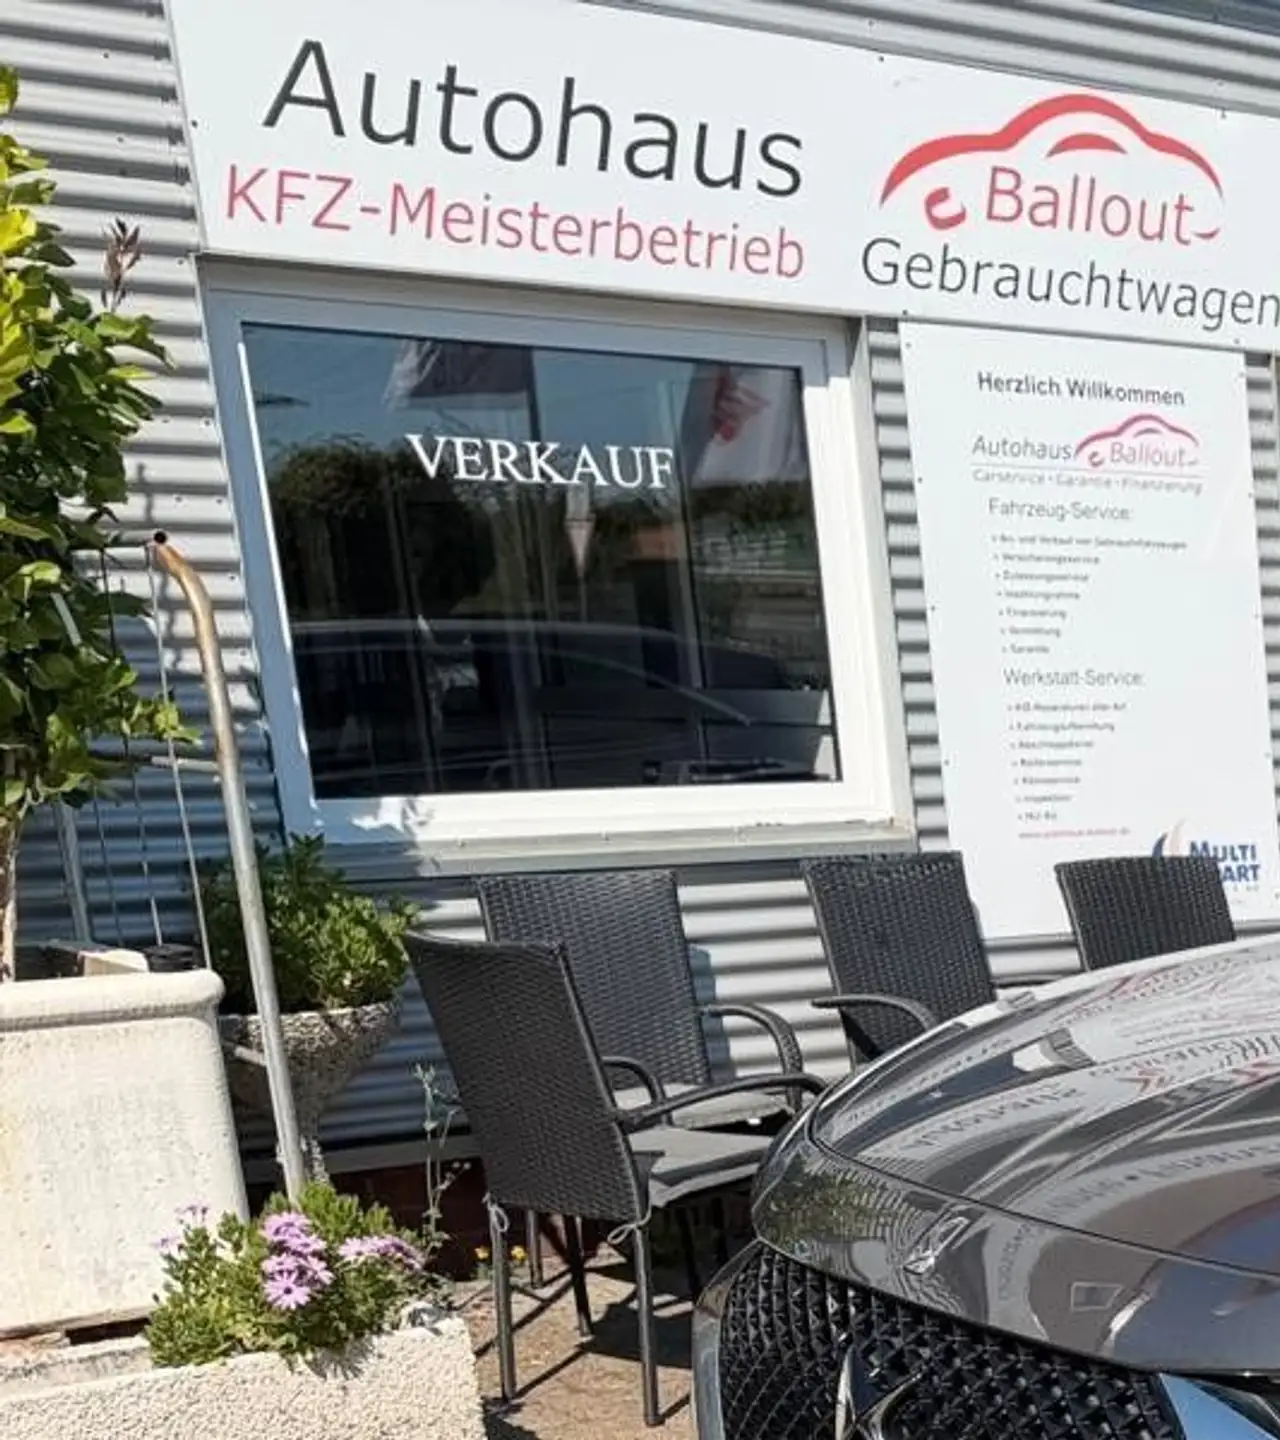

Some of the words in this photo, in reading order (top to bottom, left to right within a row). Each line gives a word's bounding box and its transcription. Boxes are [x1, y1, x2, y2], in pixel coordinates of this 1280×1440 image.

[262, 39, 803, 197] Autohaus
[225, 164, 804, 279] KFZ-Meisterbetrieb
[985, 166, 1193, 246] Ballout
[861, 237, 1280, 331] Gebrauchtwagen
[977, 371, 1061, 398] Herzlich
[1066, 379, 1185, 406] Willkommen
[404, 433, 674, 489] VERKAUF
[972, 436, 1072, 461] Autohaus
[1110, 441, 1187, 467] Ballout
[1220, 863, 1261, 882] ART
